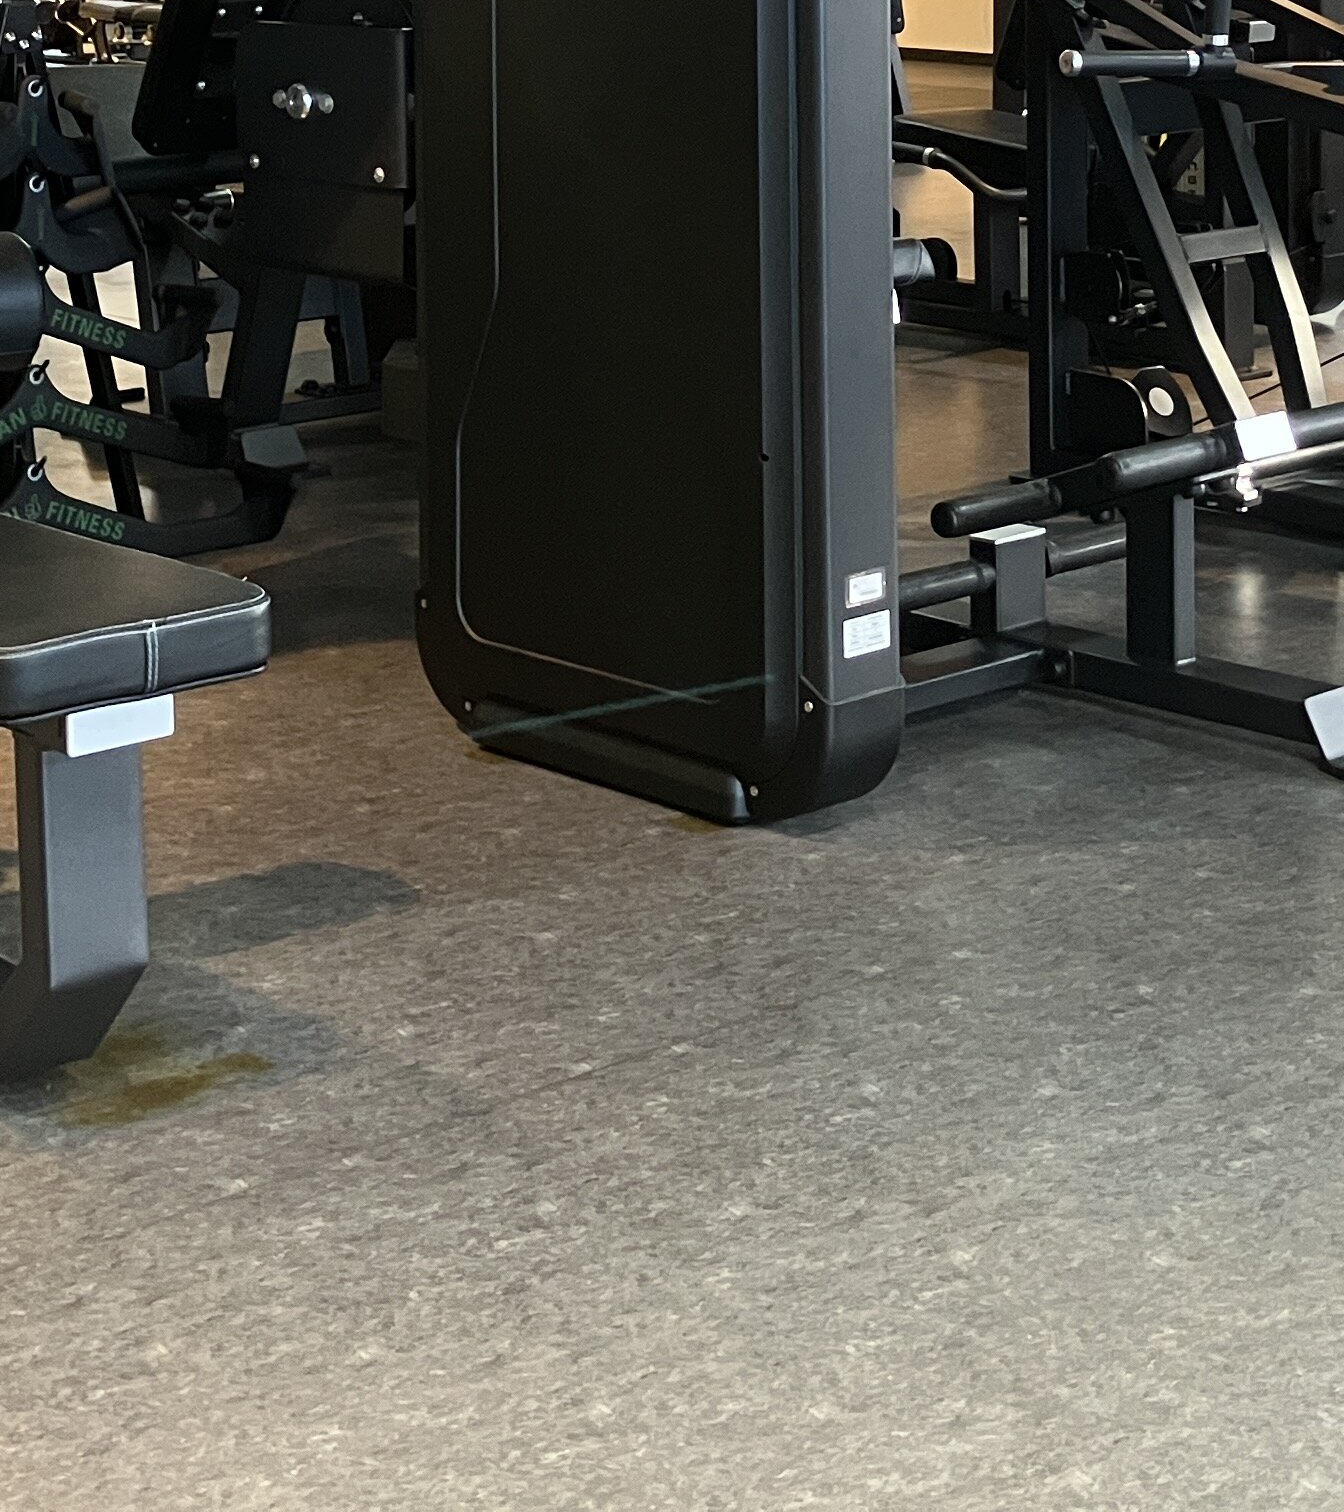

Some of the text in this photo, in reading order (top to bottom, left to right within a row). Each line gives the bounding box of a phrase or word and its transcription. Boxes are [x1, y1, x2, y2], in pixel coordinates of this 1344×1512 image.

[50, 308, 127, 350] FITNESS
[51, 401, 128, 442] FITNESS
[46, 501, 126, 541] FITNESS
